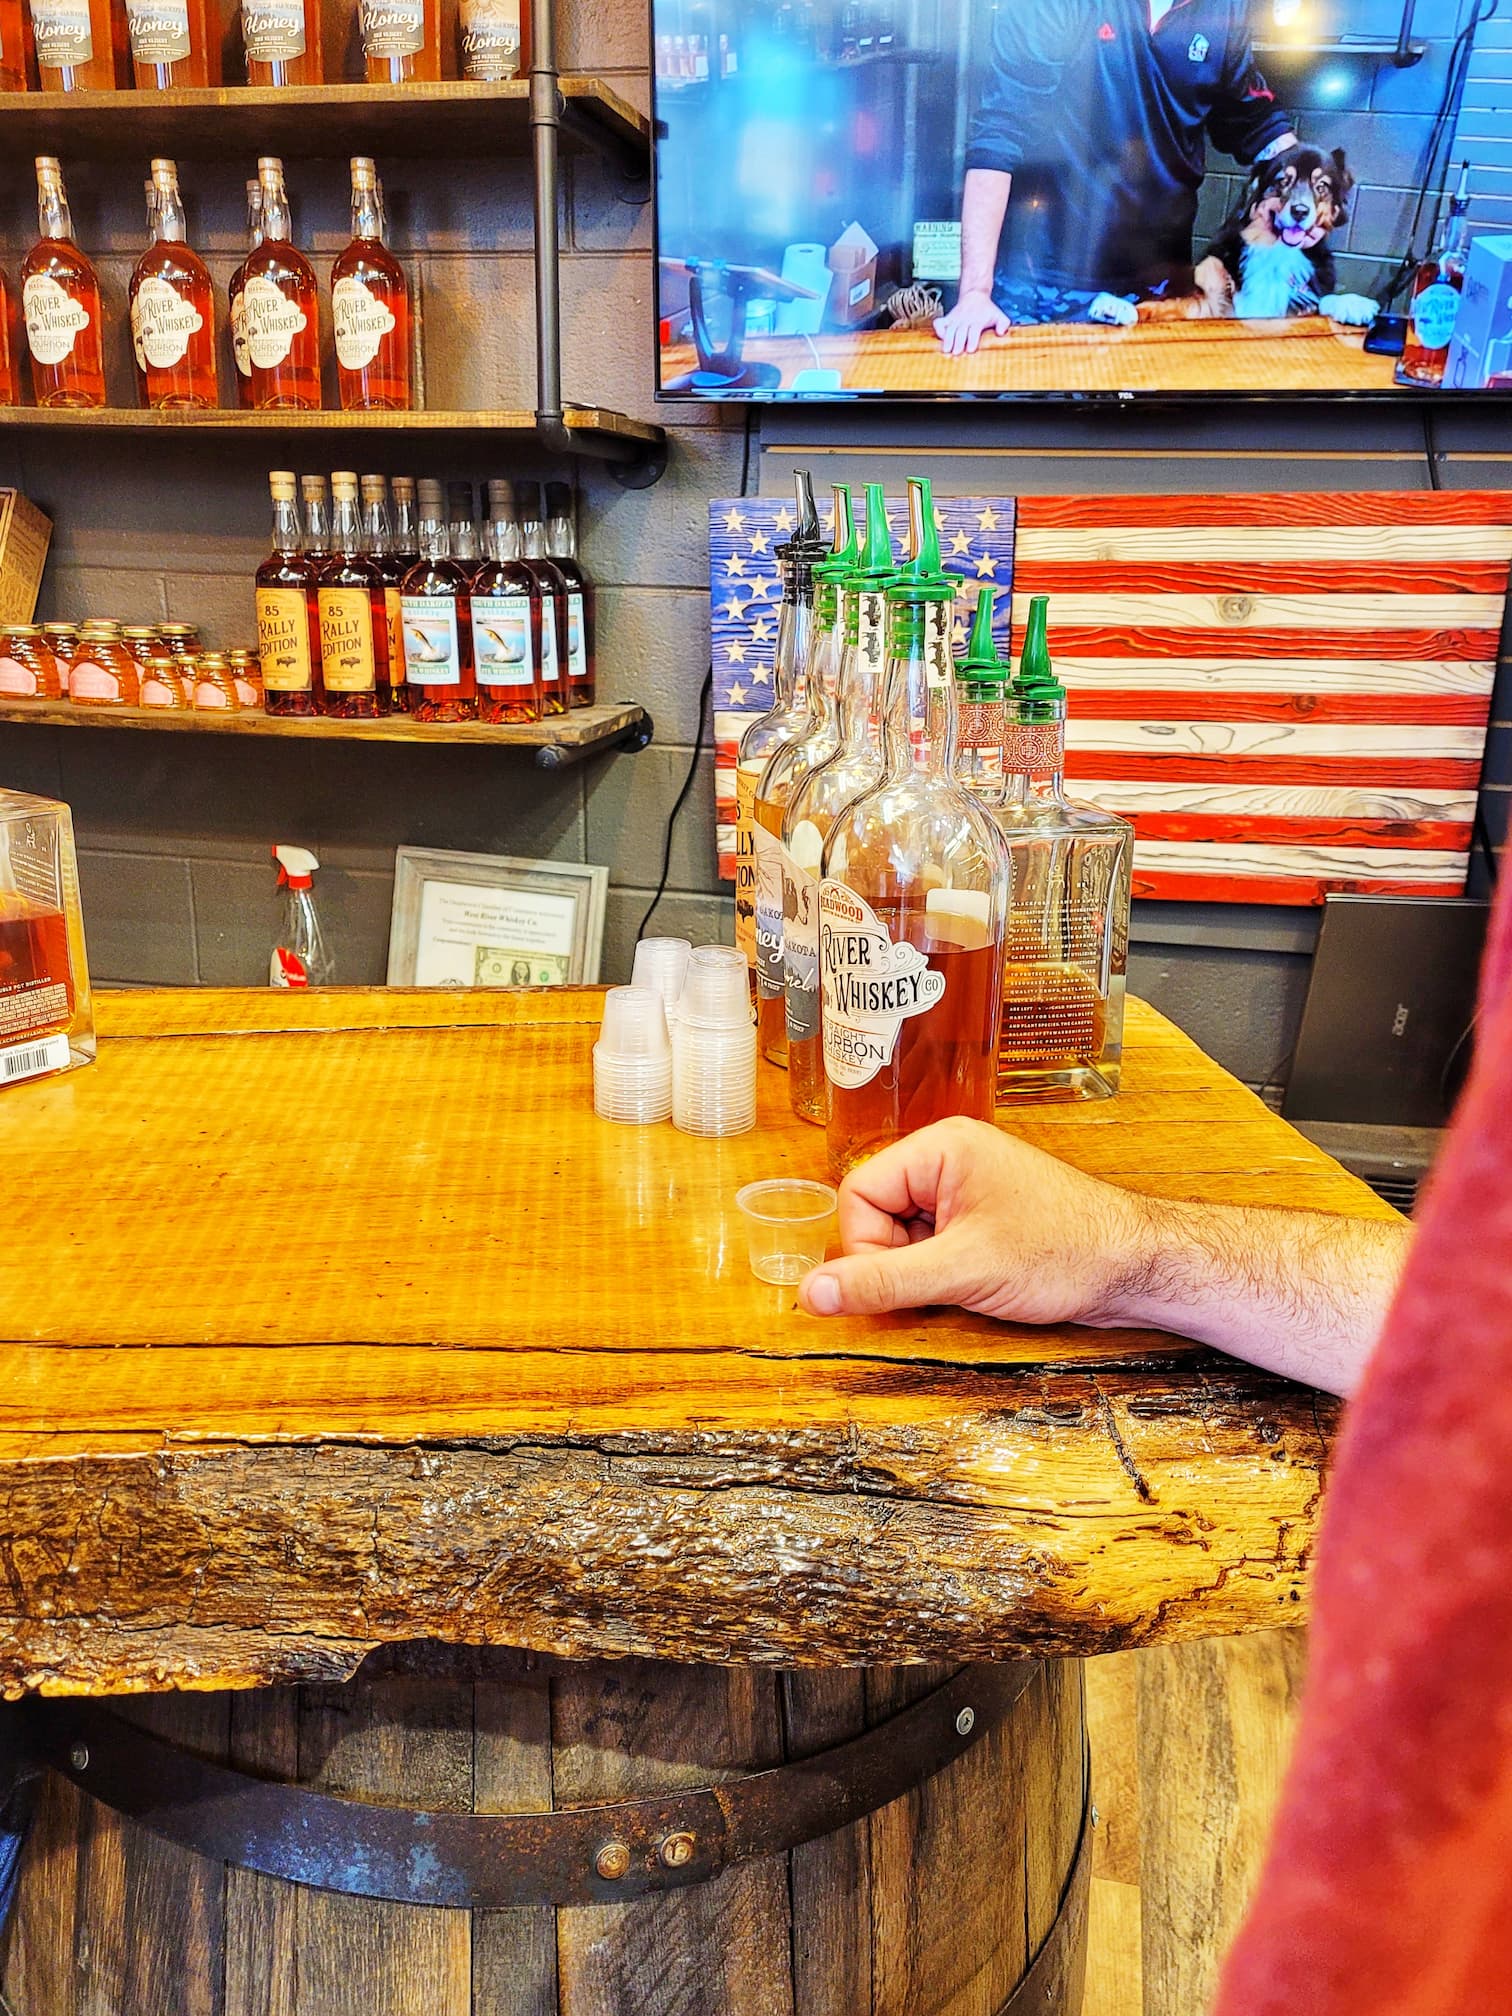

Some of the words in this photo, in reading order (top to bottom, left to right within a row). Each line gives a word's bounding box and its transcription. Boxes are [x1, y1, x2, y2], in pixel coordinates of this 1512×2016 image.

[34, 21, 87, 44] Honey
[129, 18, 185, 39] Honey
[245, 15, 301, 37] Honey
[363, 11, 420, 33] Honey
[462, 31, 516, 55] Honey
[32, 295, 60, 318] RIVER
[146, 298, 174, 321] RIVER
[251, 298, 278, 321] RIVER
[340, 299, 366, 321] RIVER
[41, 312, 81, 331] WHISKEY
[156, 316, 194, 334] WHISKEY
[260, 315, 298, 334] WHISKEY
[348, 316, 386, 335] WHISKEY
[265, 605, 279, 616] 85
[328, 606, 343, 616] 85
[260, 619, 295, 640] RALLY
[322, 619, 359, 641] RALLY
[260, 637, 297, 659] EDITION
[322, 637, 361, 660] EDITION
[821, 895, 863, 922] EADWOOD
[784, 938, 817, 957] AKOTA
[822, 924, 871, 974] RIVER
[834, 971, 921, 1016] WHISKEY
[925, 979, 939, 992] CO
[1045, 1036, 1093, 1044] PRODUCTIVITY
[825, 1043, 864, 1065] HISKEY
